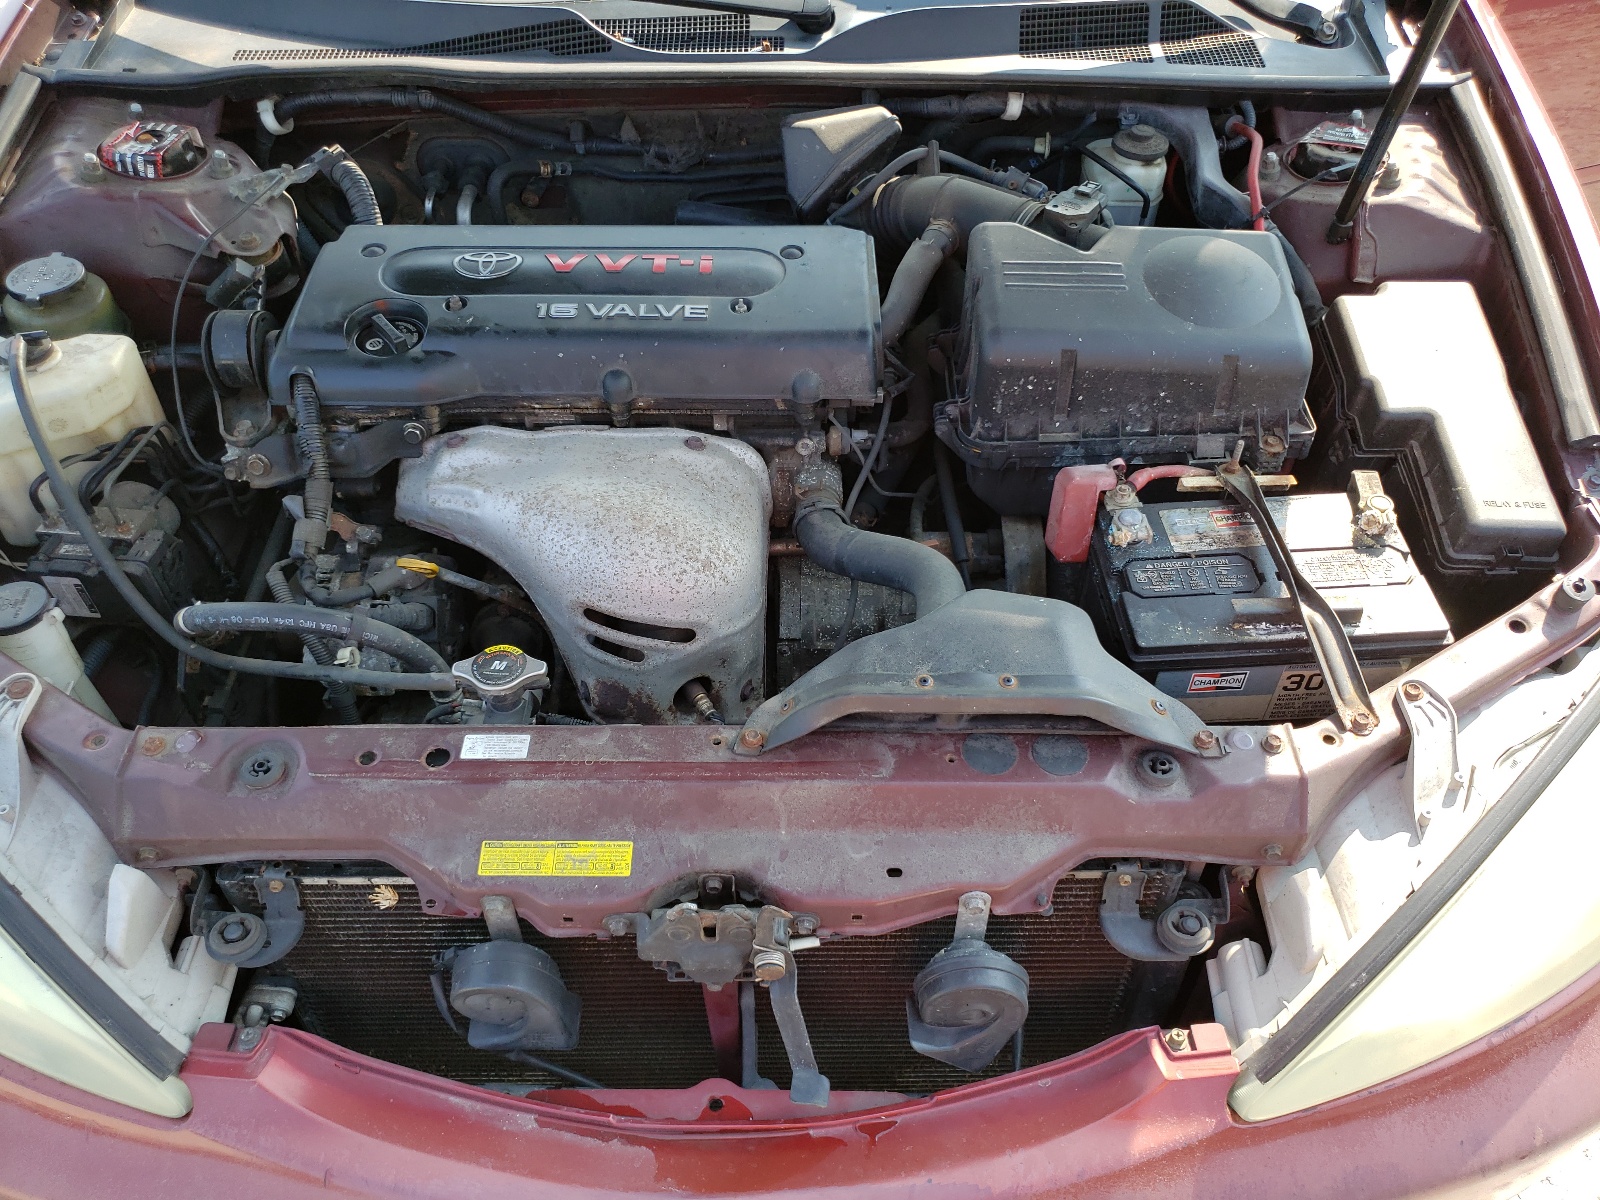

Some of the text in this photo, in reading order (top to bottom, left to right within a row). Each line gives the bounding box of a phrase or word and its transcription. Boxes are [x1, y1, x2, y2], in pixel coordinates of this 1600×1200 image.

[536, 302, 709, 320] 16 VALVE
[1522, 501, 1547, 509] FUSE
[1215, 512, 1252, 522] CHAMPIO
[1154, 560, 1189, 568] DANGER
[490, 660, 508, 671] M
[1193, 676, 1243, 687] CHAMPION
[1282, 673, 1324, 692] 30
